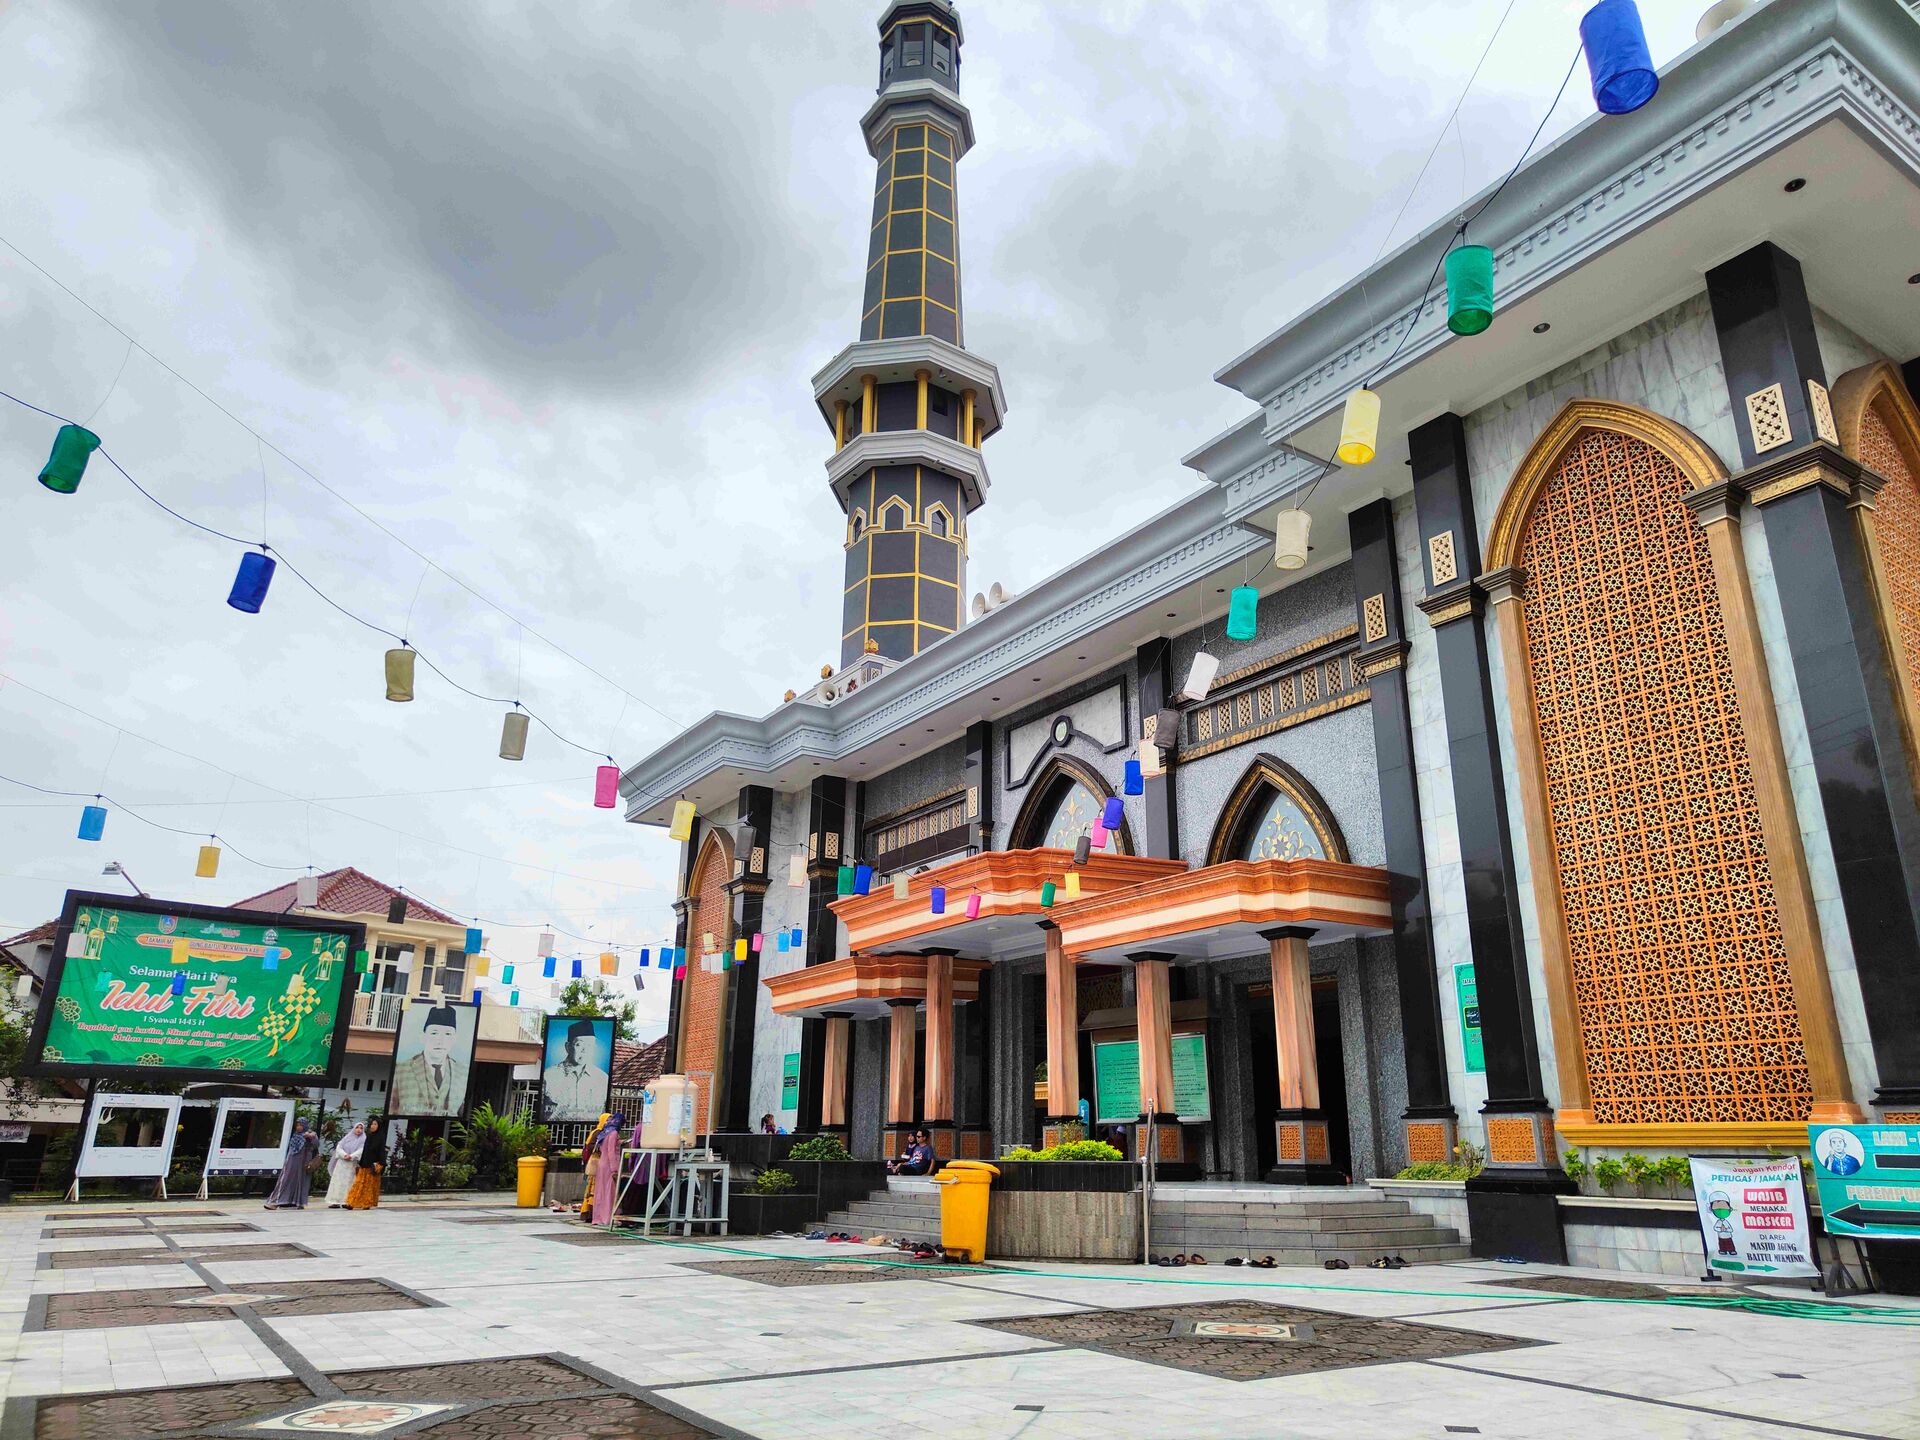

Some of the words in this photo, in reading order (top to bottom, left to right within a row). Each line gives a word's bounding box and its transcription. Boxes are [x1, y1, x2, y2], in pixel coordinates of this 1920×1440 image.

[129, 965, 177, 978] Selamat
[182, 970, 207, 981] Hari
[101, 979, 174, 1013] Idul
[184, 984, 256, 1019] Fitri
[149, 1016, 177, 1025] Syawal
[1732, 1166, 1764, 1175] Jangan
[1765, 1163, 1796, 1173] Kendor
[1711, 1174, 1752, 1183] PETUGAS
[1747, 1191, 1784, 1202] WAJIB
[1745, 1215, 1792, 1227] MASKER
[1759, 1233, 1768, 1241] DI
[1749, 1242, 1776, 1251] MASJID
[1746, 1252, 1773, 1262] BAITUL
